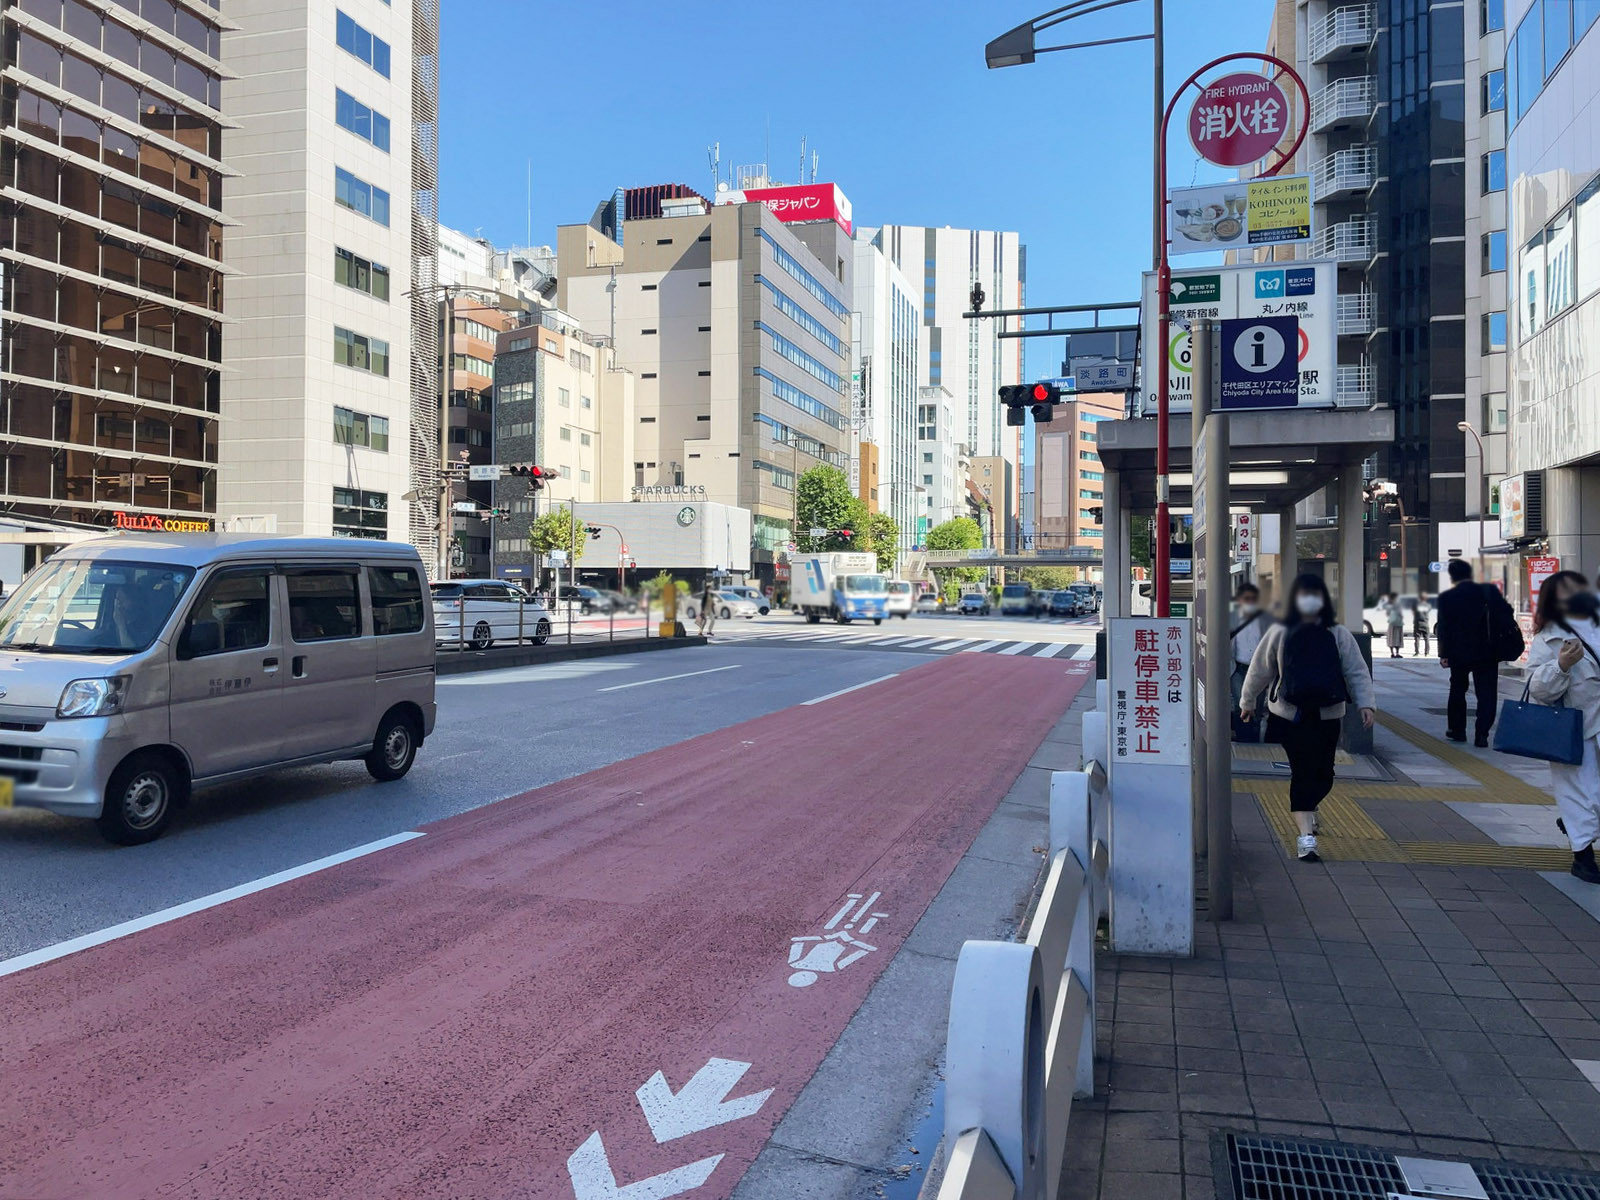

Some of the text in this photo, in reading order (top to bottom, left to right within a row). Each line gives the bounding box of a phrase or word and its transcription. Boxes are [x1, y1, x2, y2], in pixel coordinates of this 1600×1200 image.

[1205, 81, 1271, 100] FIRE HYDRANT
[1198, 96, 1281, 142] 消火栓
[1249, 196, 1308, 209] KOHINOOR
[1262, 302, 1308, 314] 丸ノ内線
[1080, 367, 1127, 379] 淡路町
[1222, 379, 1297, 390] 千代田区エリアマップ
[1300, 386, 1320, 396] Sta.
[1222, 387, 1297, 398] Chiyoda City Area Map
[631, 485, 705, 495] STARBUCKS
[113, 511, 210, 533] TULLY'S COFFEE
[1166, 626, 1182, 703] 赤い部分は
[1134, 629, 1161, 754] 駐停車禁止
[1117, 690, 1128, 757] 警視庁・東京都
